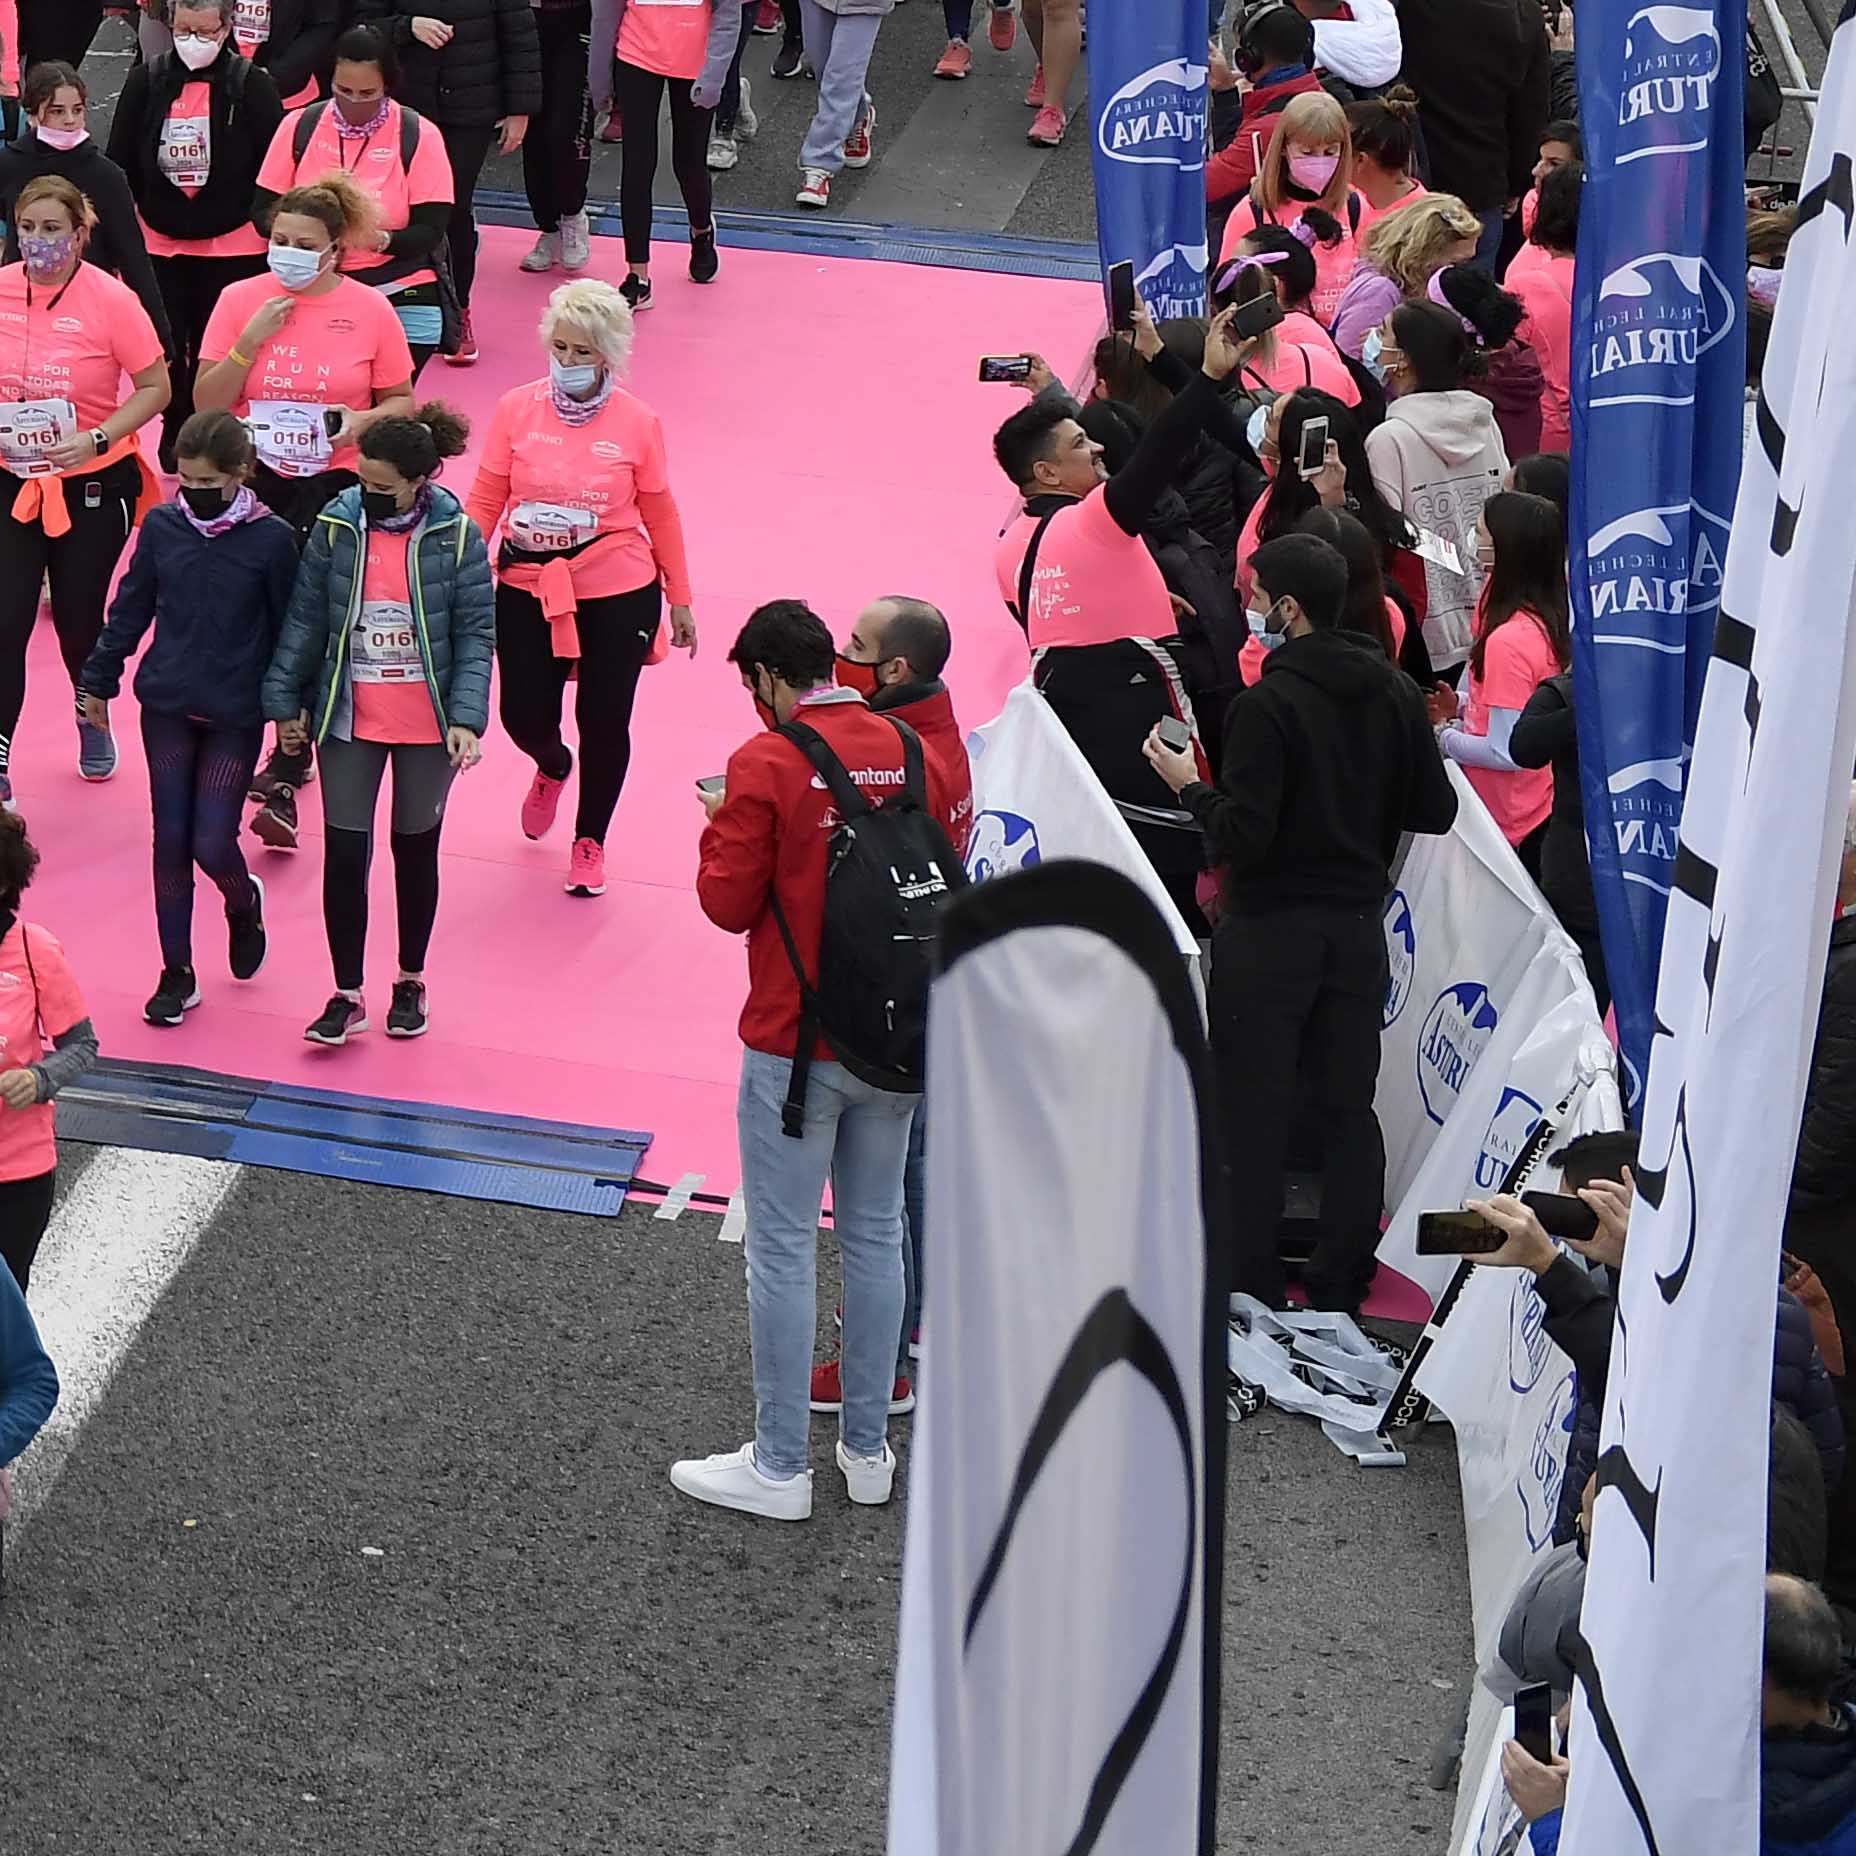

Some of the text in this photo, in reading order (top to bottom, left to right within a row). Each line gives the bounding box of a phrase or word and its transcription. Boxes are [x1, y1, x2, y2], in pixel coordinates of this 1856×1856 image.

[272, 344, 297, 358] WE
[43, 365, 70, 376] POR
[263, 376, 327, 392] FOR A
[274, 432, 309, 446] 016
[372, 632, 411, 648] 016
